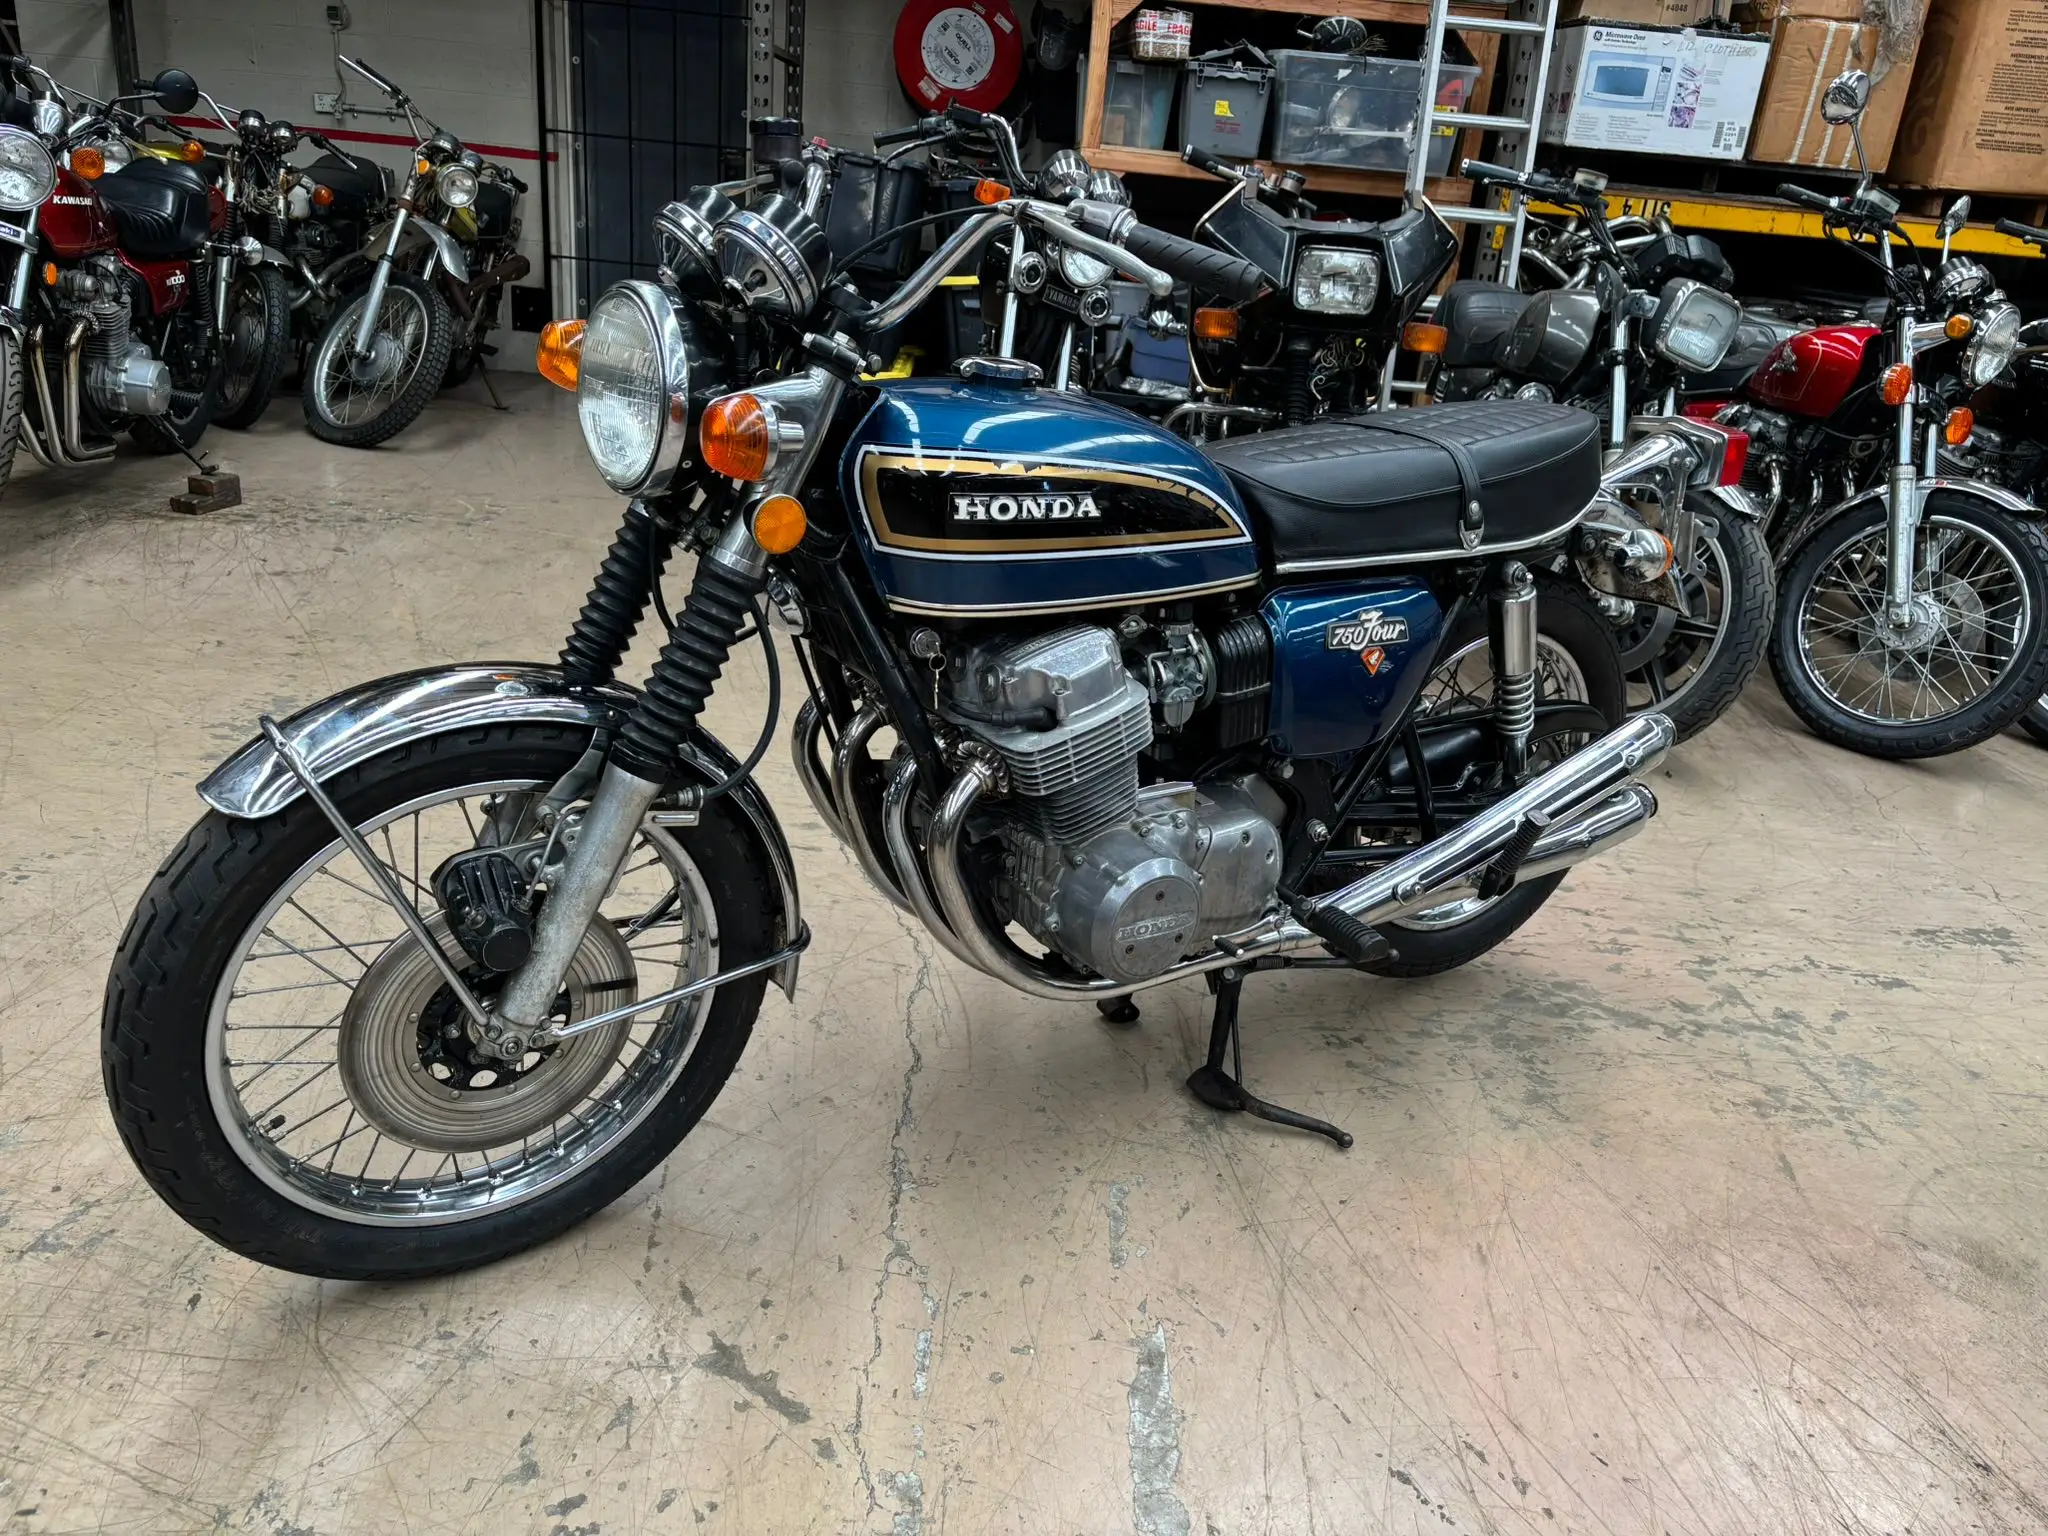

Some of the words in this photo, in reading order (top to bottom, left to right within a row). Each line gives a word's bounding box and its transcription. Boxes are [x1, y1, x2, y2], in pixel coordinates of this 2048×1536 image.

[1167, 22, 1193, 37] FRAG
[1604, 31, 1633, 40] Microwave
[955, 32, 972, 53] QUELL
[52, 194, 93, 206] KAWASAKI
[1048, 288, 1078, 309] YAMAHA
[953, 496, 1101, 520] HONDA
[1332, 626, 1364, 646] 750
[1119, 914, 1191, 938] HONDA
